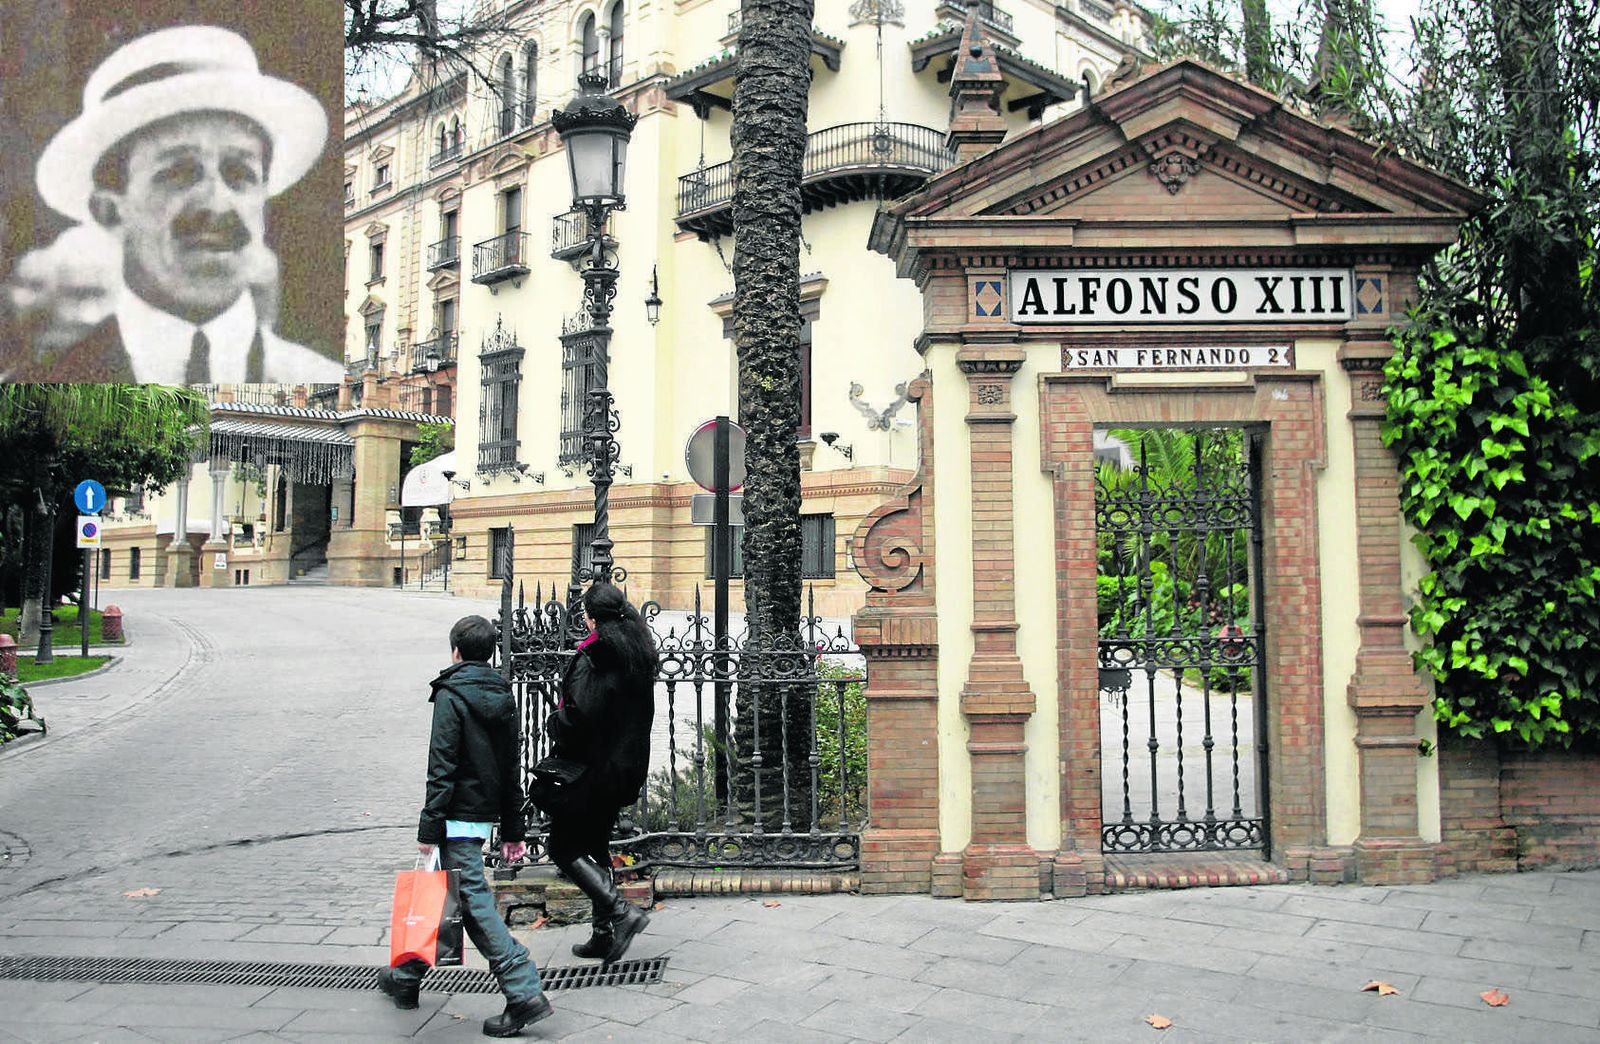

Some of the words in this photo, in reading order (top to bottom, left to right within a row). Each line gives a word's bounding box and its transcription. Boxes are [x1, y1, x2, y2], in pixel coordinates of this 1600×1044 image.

[1018, 276, 1238, 315] ALFONSO
[1255, 276, 1345, 314] XIII
[1077, 349, 1119, 367] SAN
[1137, 348, 1251, 366] FERNANDO
[1268, 348, 1280, 364] 2
